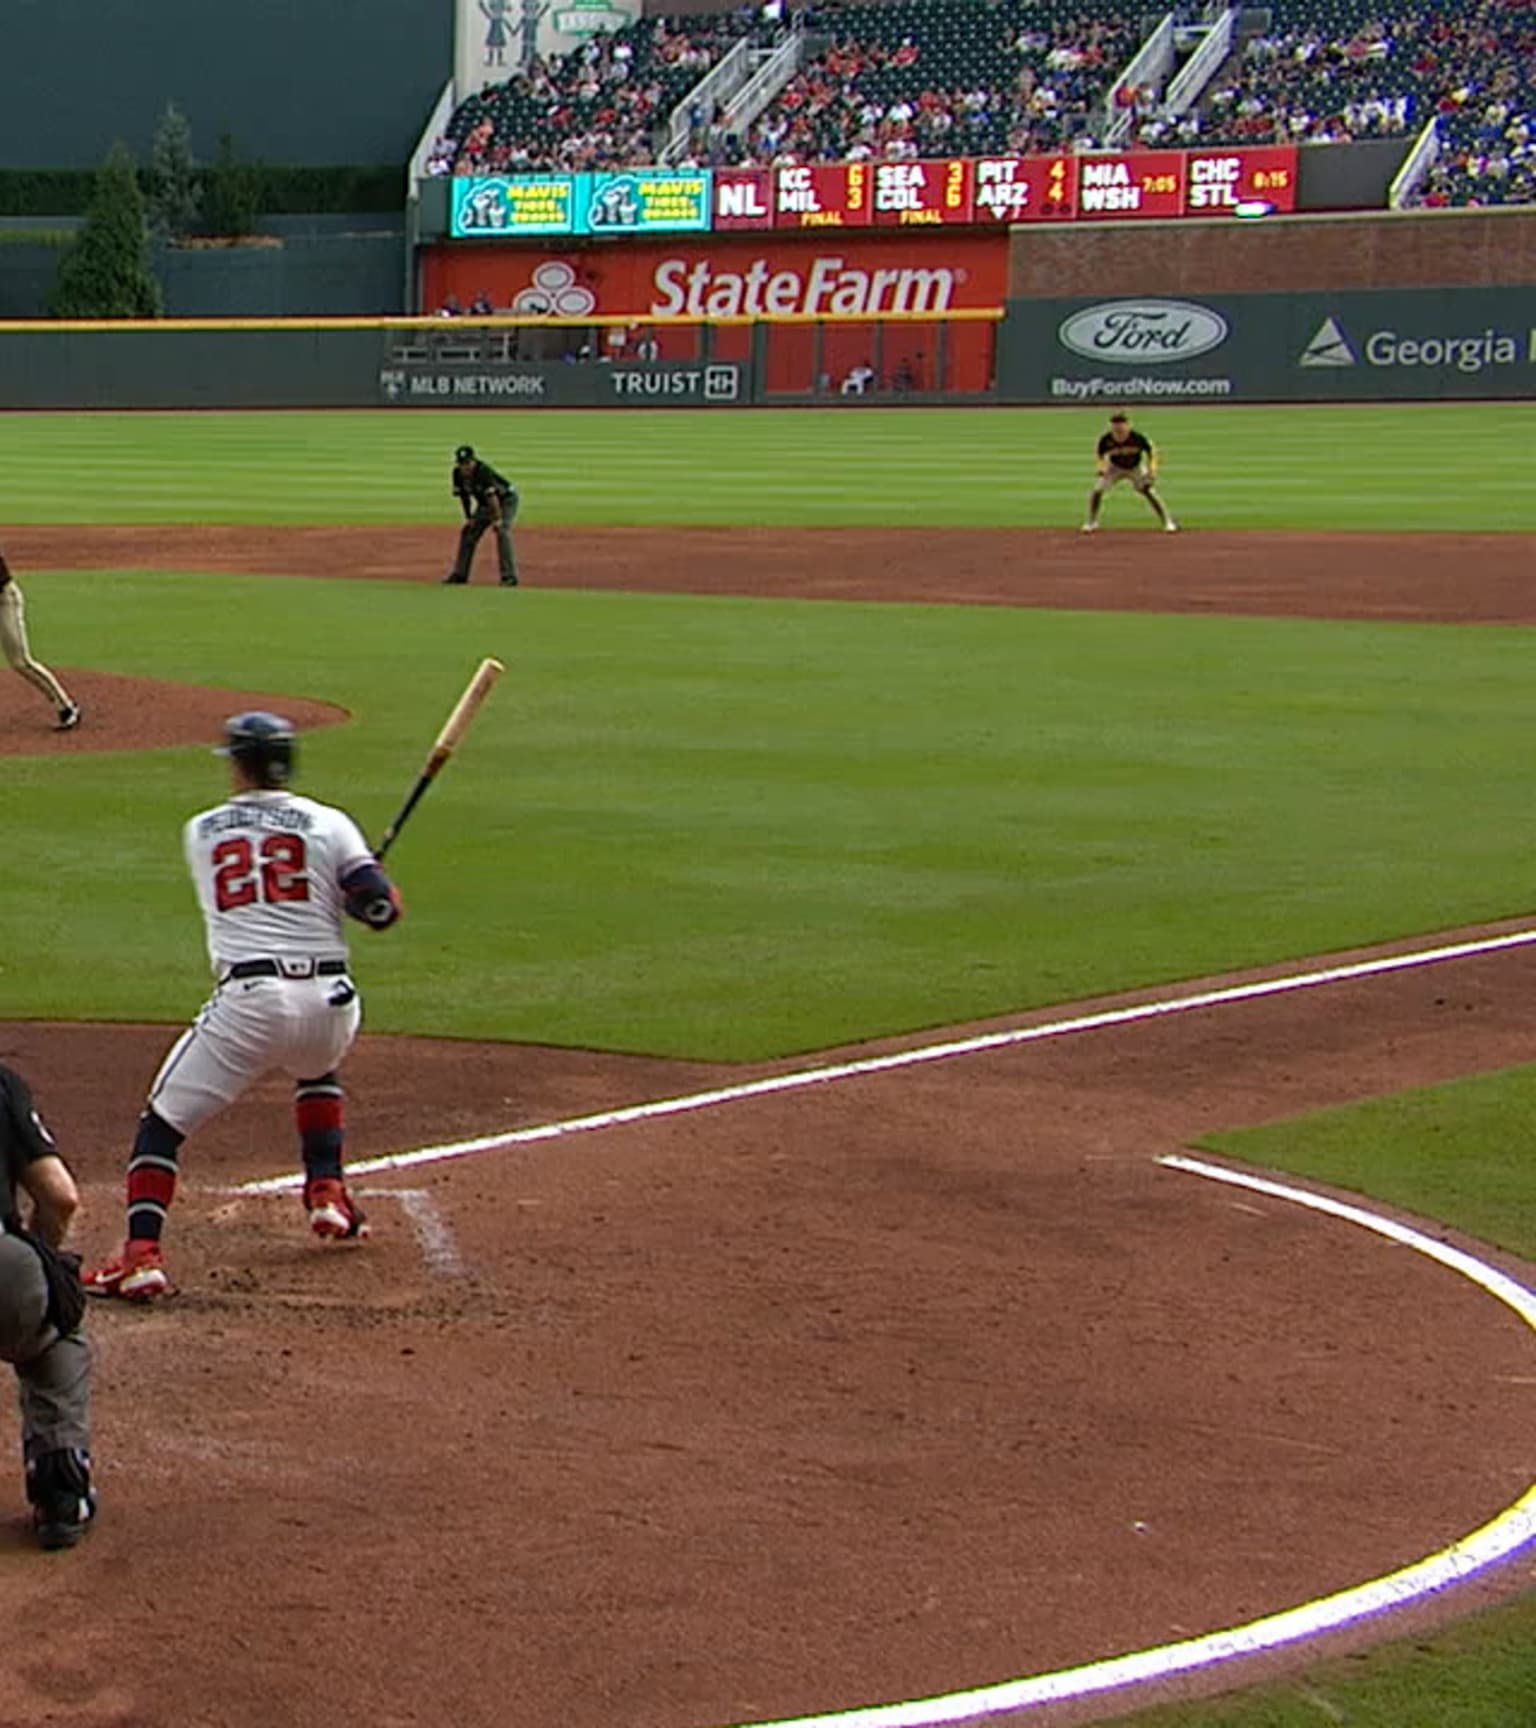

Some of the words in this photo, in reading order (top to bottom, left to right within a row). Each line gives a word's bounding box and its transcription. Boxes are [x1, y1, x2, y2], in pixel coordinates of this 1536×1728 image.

[779, 168, 812, 190] KC
[848, 165, 862, 187] 6
[877, 165, 925, 187] SEA
[948, 162, 962, 183] 3
[976, 161, 1019, 183] PIT
[1050, 161, 1065, 179] 4
[1082, 164, 1130, 186] MIA
[1143, 175, 1176, 192] 7:05
[1191, 158, 1240, 181] CHC
[719, 184, 766, 216] NL
[778, 190, 821, 212] MIL
[848, 187, 862, 209] 3
[876, 188, 924, 210] COL
[947, 186, 961, 207] 6
[976, 184, 1028, 206] ARZ
[1049, 183, 1064, 202] 4
[1081, 187, 1141, 210] WSH
[1190, 184, 1239, 207] STL
[801, 211, 843, 226] FINAL
[900, 210, 942, 224] FINAL
[1094, 311, 1192, 349] Ford
[1367, 329, 1515, 372] Georgia
[412, 376, 449, 394] MLB
[454, 375, 544, 394] NETWORK
[612, 371, 700, 395] TRUIST
[1052, 377, 1231, 398] BuyFordNow.com
[210, 833, 309, 912] 22
